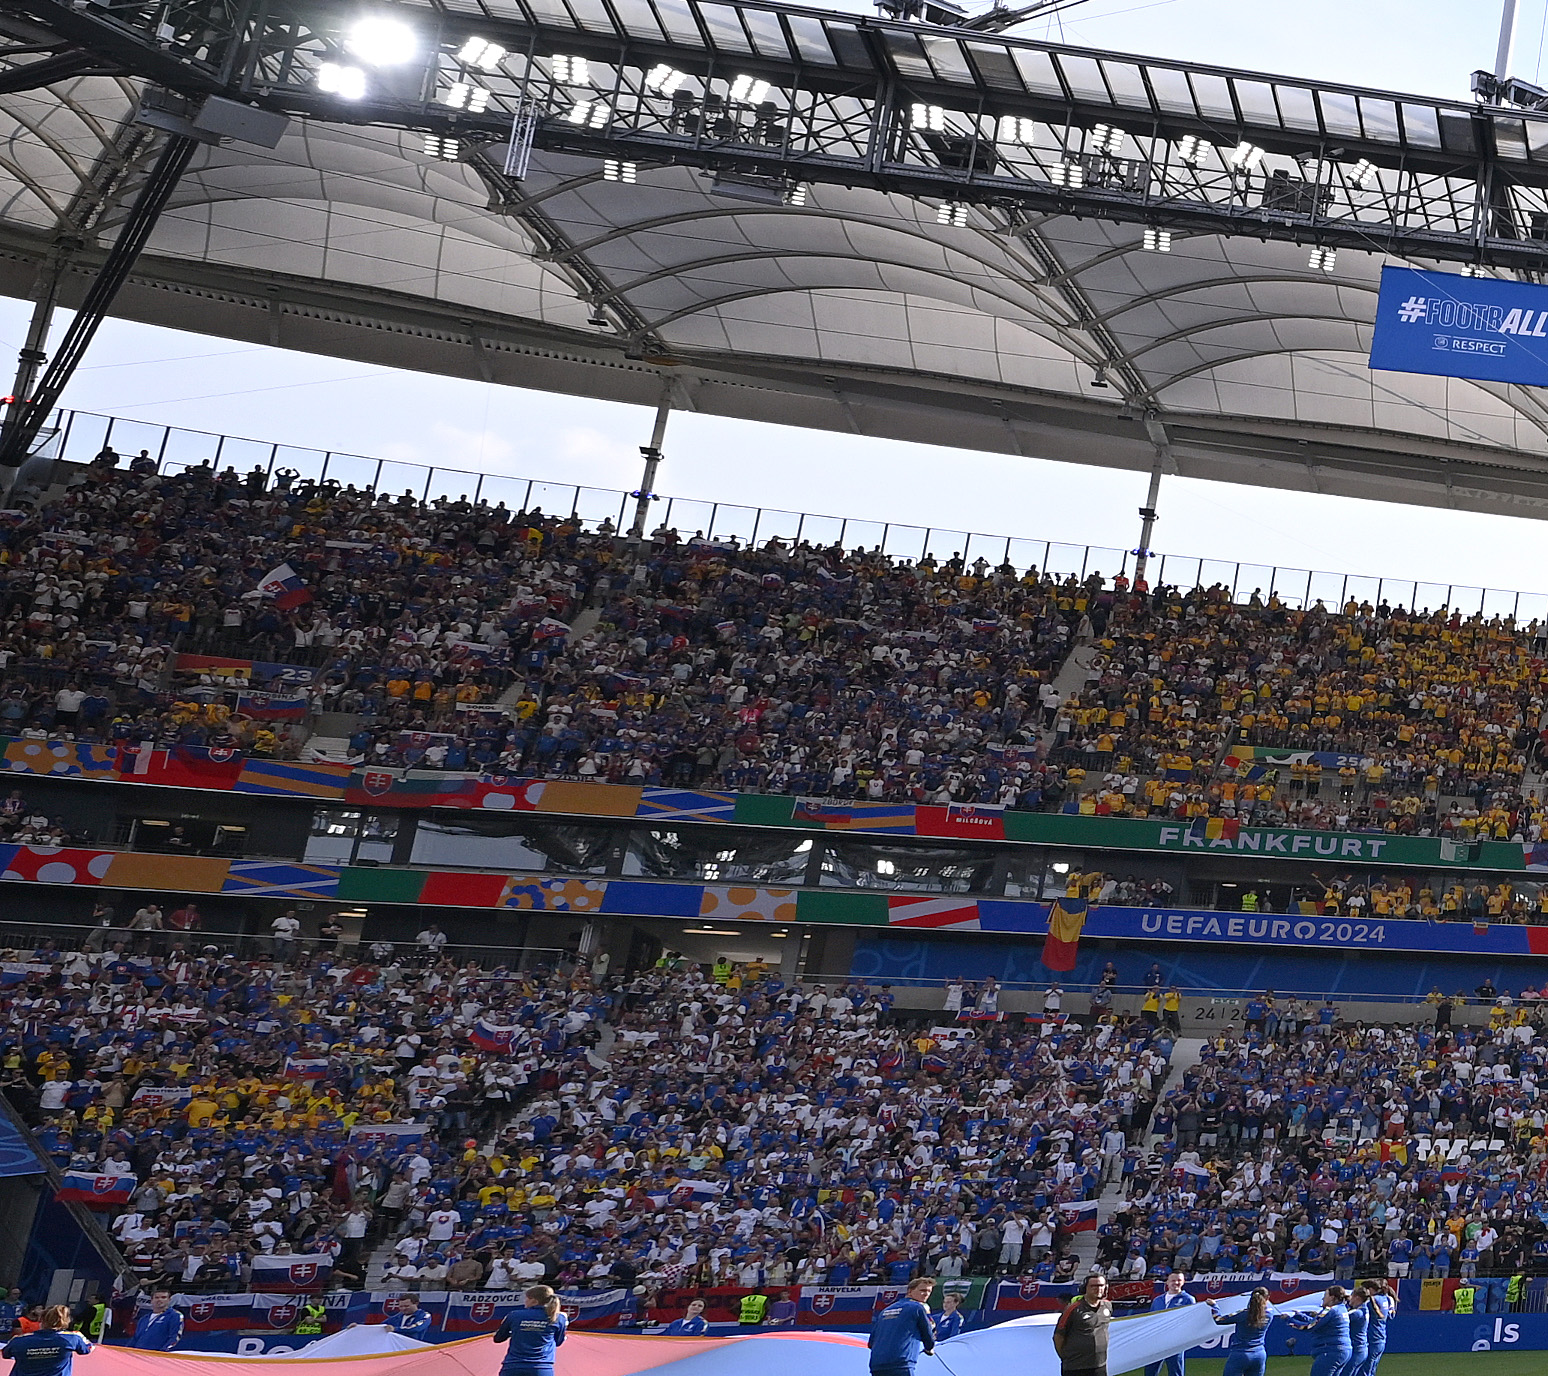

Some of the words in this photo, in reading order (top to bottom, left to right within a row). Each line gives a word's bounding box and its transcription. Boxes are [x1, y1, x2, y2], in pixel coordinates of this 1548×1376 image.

[1398, 296, 1548, 338] #FOOTBALL
[1452, 339, 1507, 354] RESPECT
[281, 668, 312, 681] 23
[1336, 755, 1360, 767] 25
[1195, 1007, 1215, 1020] 24
[463, 1294, 521, 1304] RADZOVCE
